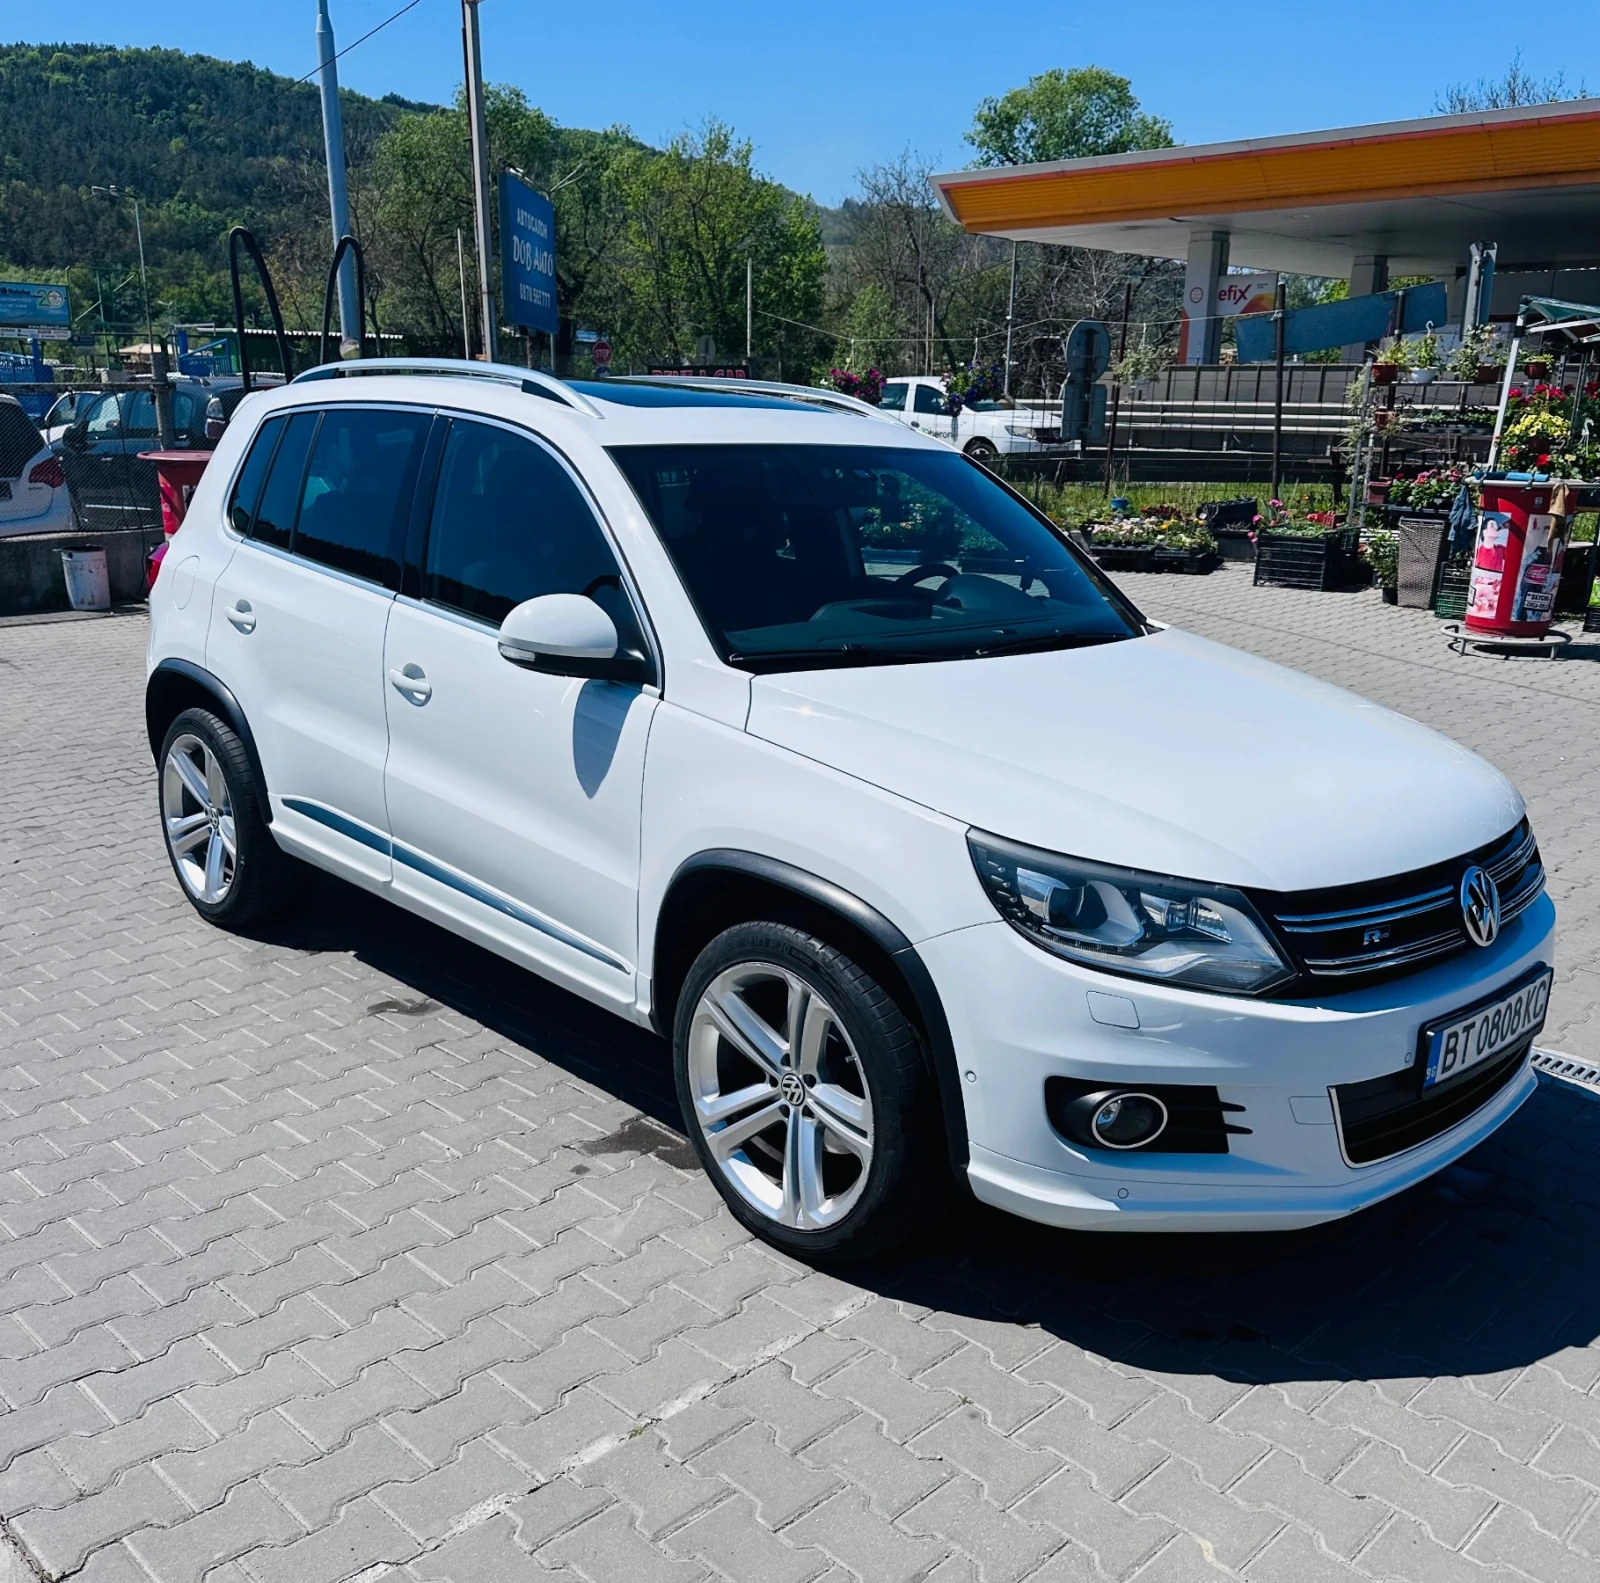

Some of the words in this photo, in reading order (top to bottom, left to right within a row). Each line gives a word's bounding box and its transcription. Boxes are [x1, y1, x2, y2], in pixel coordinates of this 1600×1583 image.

[512, 234, 532, 273] DOB
[1217, 283, 1252, 306] efix
[594, 348, 611, 359] STOP
